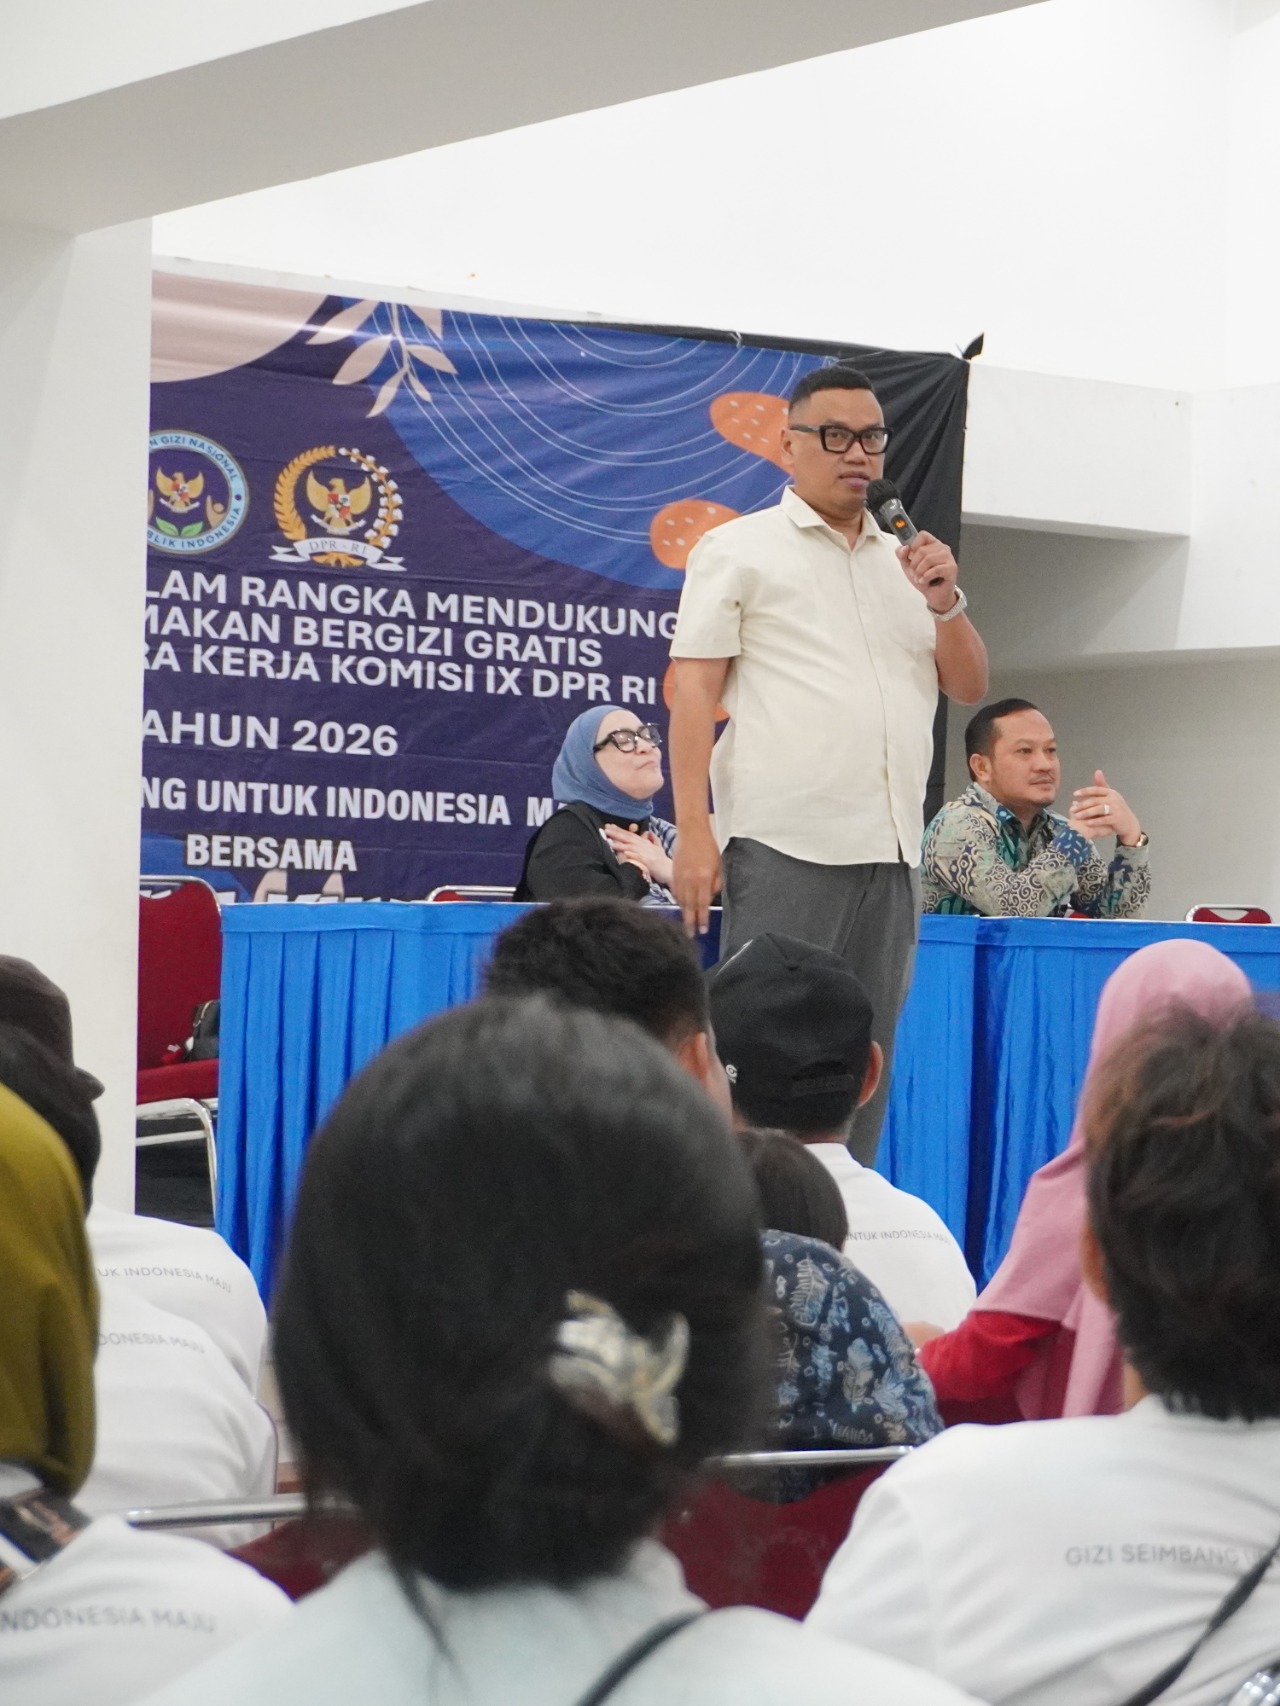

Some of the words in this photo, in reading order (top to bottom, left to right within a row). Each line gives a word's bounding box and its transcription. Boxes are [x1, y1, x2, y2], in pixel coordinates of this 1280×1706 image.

[161, 435, 186, 445] GIZI
[189, 438, 239, 482] NASIONAL
[181, 507, 241, 548] INDONESIA
[309, 540, 337, 552] DPR
[351, 543, 367, 555] RI
[240, 575, 416, 619] RANGKA
[427, 591, 679, 640] MENDUKUNG
[293, 615, 453, 657] BERGIZI
[464, 630, 603, 668] GRATIS
[193, 643, 321, 682] KERJA
[331, 653, 474, 693] KOMISI
[486, 665, 523, 696] IX
[532, 668, 612, 702] DPR
[621, 675, 656, 705] RI
[291, 719, 399, 757] 2026
[197, 779, 318, 817] UNTUK
[326, 786, 511, 826] INDONESIA
[187, 833, 358, 872] BERSAMA
[124, 1266, 203, 1280] INDONESIA
[205, 1274, 232, 1294] MAJU
[1065, 1544, 1113, 1566] GIZI
[1120, 1543, 1240, 1566] SEIMBANG
